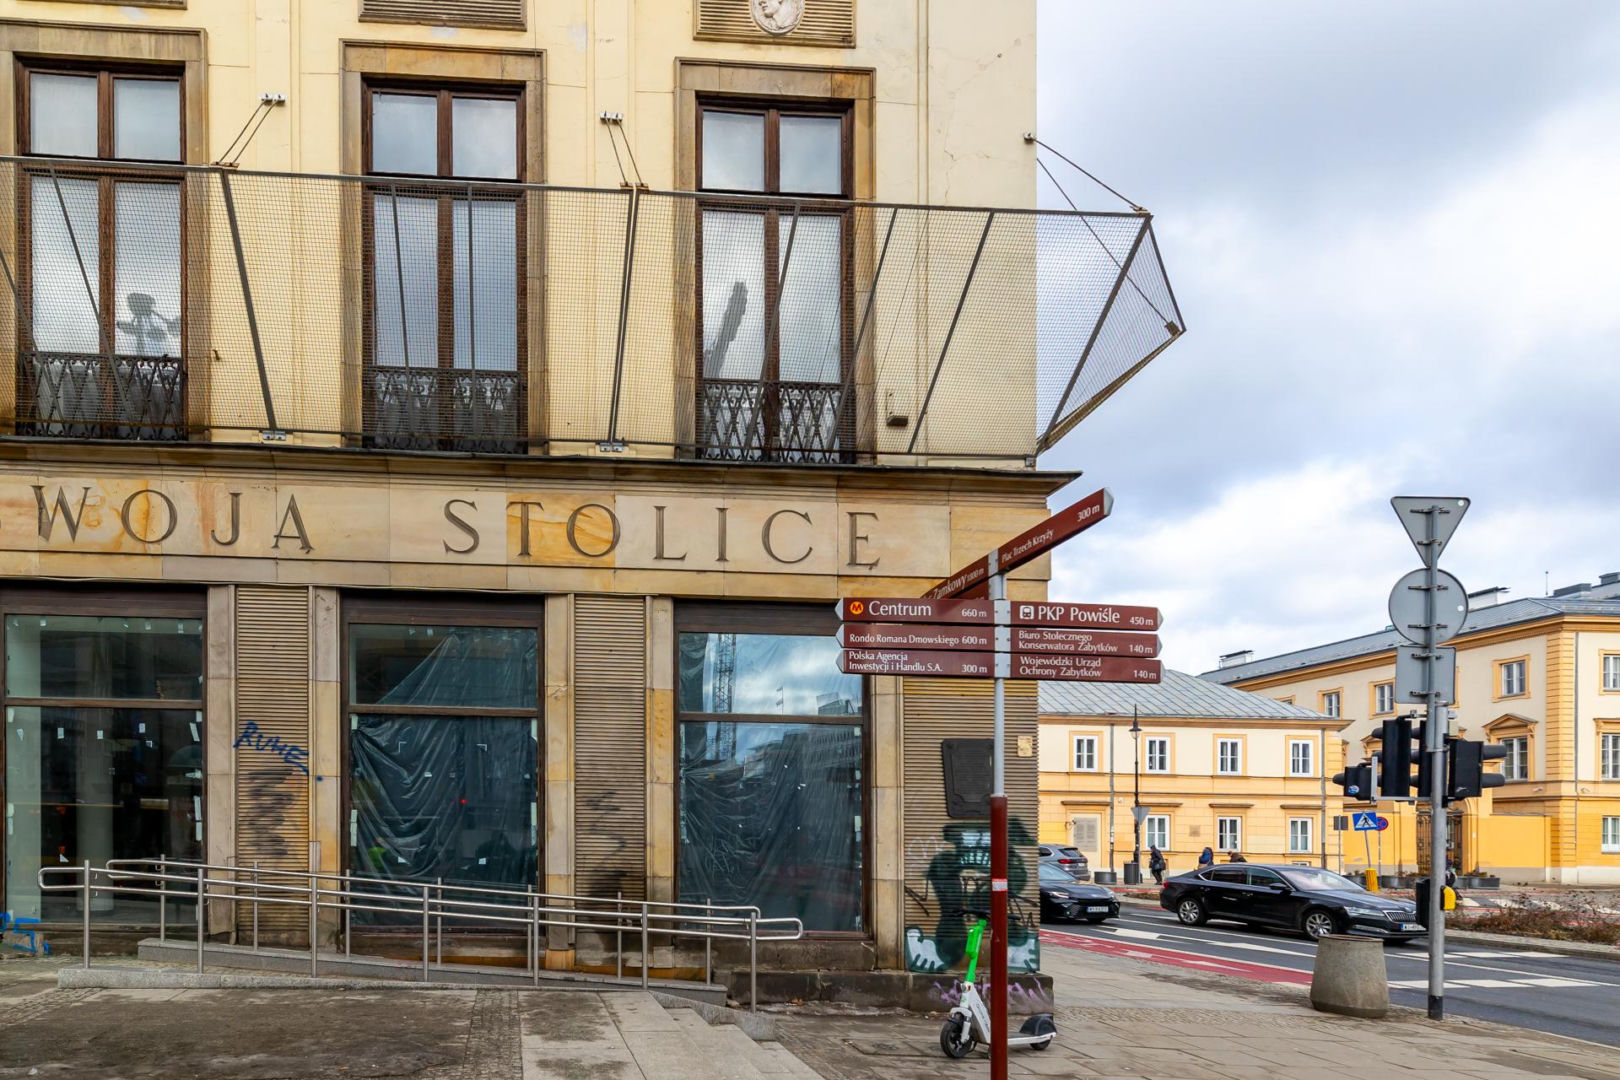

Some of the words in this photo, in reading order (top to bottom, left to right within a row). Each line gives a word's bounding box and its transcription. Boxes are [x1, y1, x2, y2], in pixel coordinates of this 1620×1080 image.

[1077, 507, 1091, 522] 300
[1092, 504, 1100, 514] m
[0, 485, 315, 554] WOJĄ
[443, 498, 881, 571] STOLICĘ
[868, 601, 931, 616] Centrum
[961, 608, 978, 617] 660
[1038, 606, 1065, 620] PKP
[1070, 607, 1120, 623] Powiśle
[1130, 616, 1144, 625] 450
[850, 634, 875, 643] Rondo
[876, 634, 907, 643] Romana
[908, 635, 959, 647] Dmowskiego
[961, 636, 978, 645] 600
[1018, 631, 1040, 640] Biuro
[1018, 641, 1074, 651] Konserwatora
[1078, 642, 1118, 654] Zabytków
[1130, 645, 1144, 654] 140
[849, 651, 875, 660] Polska
[876, 651, 908, 663] Agencja
[1020, 656, 1073, 667] Wojewódzki
[1076, 657, 1102, 668] Urząd
[849, 661, 889, 673] Inwestycji
[896, 662, 925, 672] Handlu
[927, 663, 943, 672] S.A.
[961, 664, 978, 673] 300
[1019, 666, 1057, 678] Ochrony
[1060, 667, 1102, 678] Zabytków
[1133, 670, 1148, 679] 140
